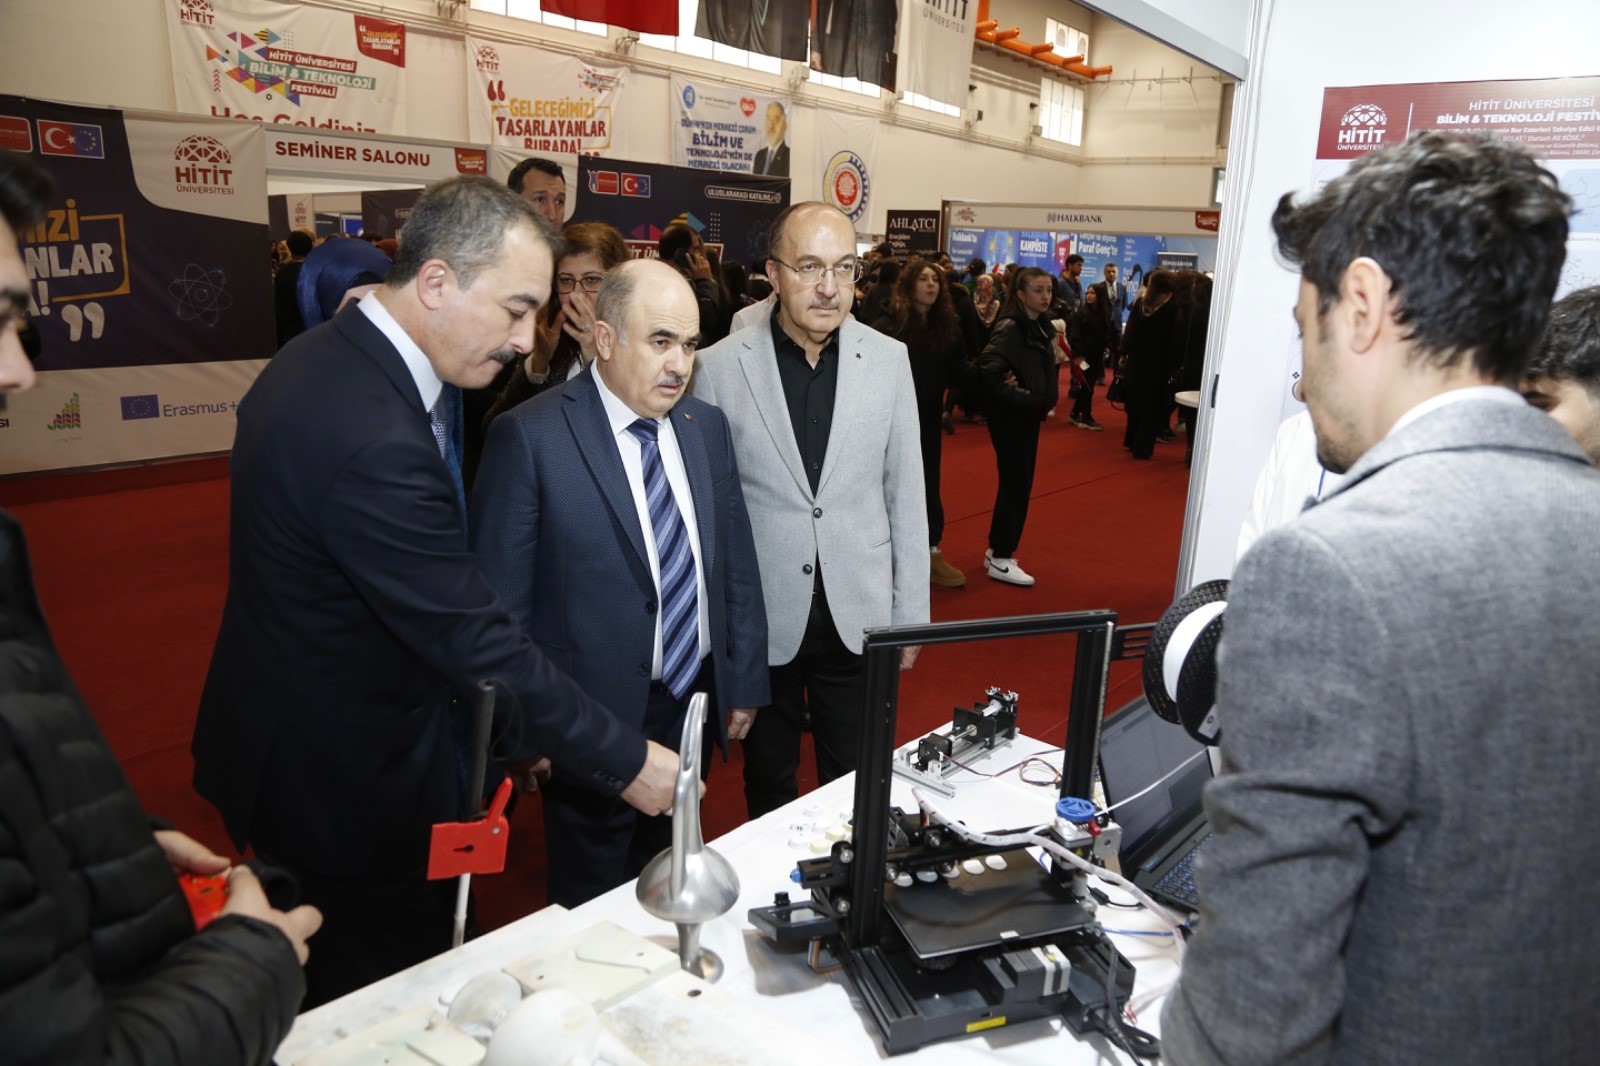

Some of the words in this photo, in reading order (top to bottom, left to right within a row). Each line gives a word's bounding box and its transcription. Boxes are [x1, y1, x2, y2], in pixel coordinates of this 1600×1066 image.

[268, 51, 293, 63] HİTİT
[294, 54, 355, 72] ÜNİVERSİTESİ
[249, 60, 287, 78] BİLİM
[289, 67, 300, 80] &
[302, 69, 373, 90] TEKNOLOJİ
[290, 83, 337, 98] FESTİVALİ
[508, 96, 596, 119] GELECEĞİMİZİ
[1469, 98, 1501, 112] HİTİT
[1503, 95, 1595, 111] ÜNİVERSİTESİ
[495, 116, 607, 138] TASARLAYANLAR
[1436, 112, 1469, 125] BİLİM
[1471, 114, 1481, 124] &
[1483, 111, 1554, 124] TEKNOLOJİ
[692, 130, 728, 149] BİLİM
[730, 136, 744, 149] VE
[1338, 126, 1386, 143] HİTİT
[275, 141, 358, 162] SEMİNER
[362, 149, 431, 167] SALONU
[1337, 142, 1385, 151] ÜNİVERSİTESİ
[175, 163, 233, 186] HİTİT
[176, 184, 234, 195] ÜNİVERSİTESİ
[1057, 213, 1103, 223] HALKBANK
[163, 400, 238, 419] Erasmus+
